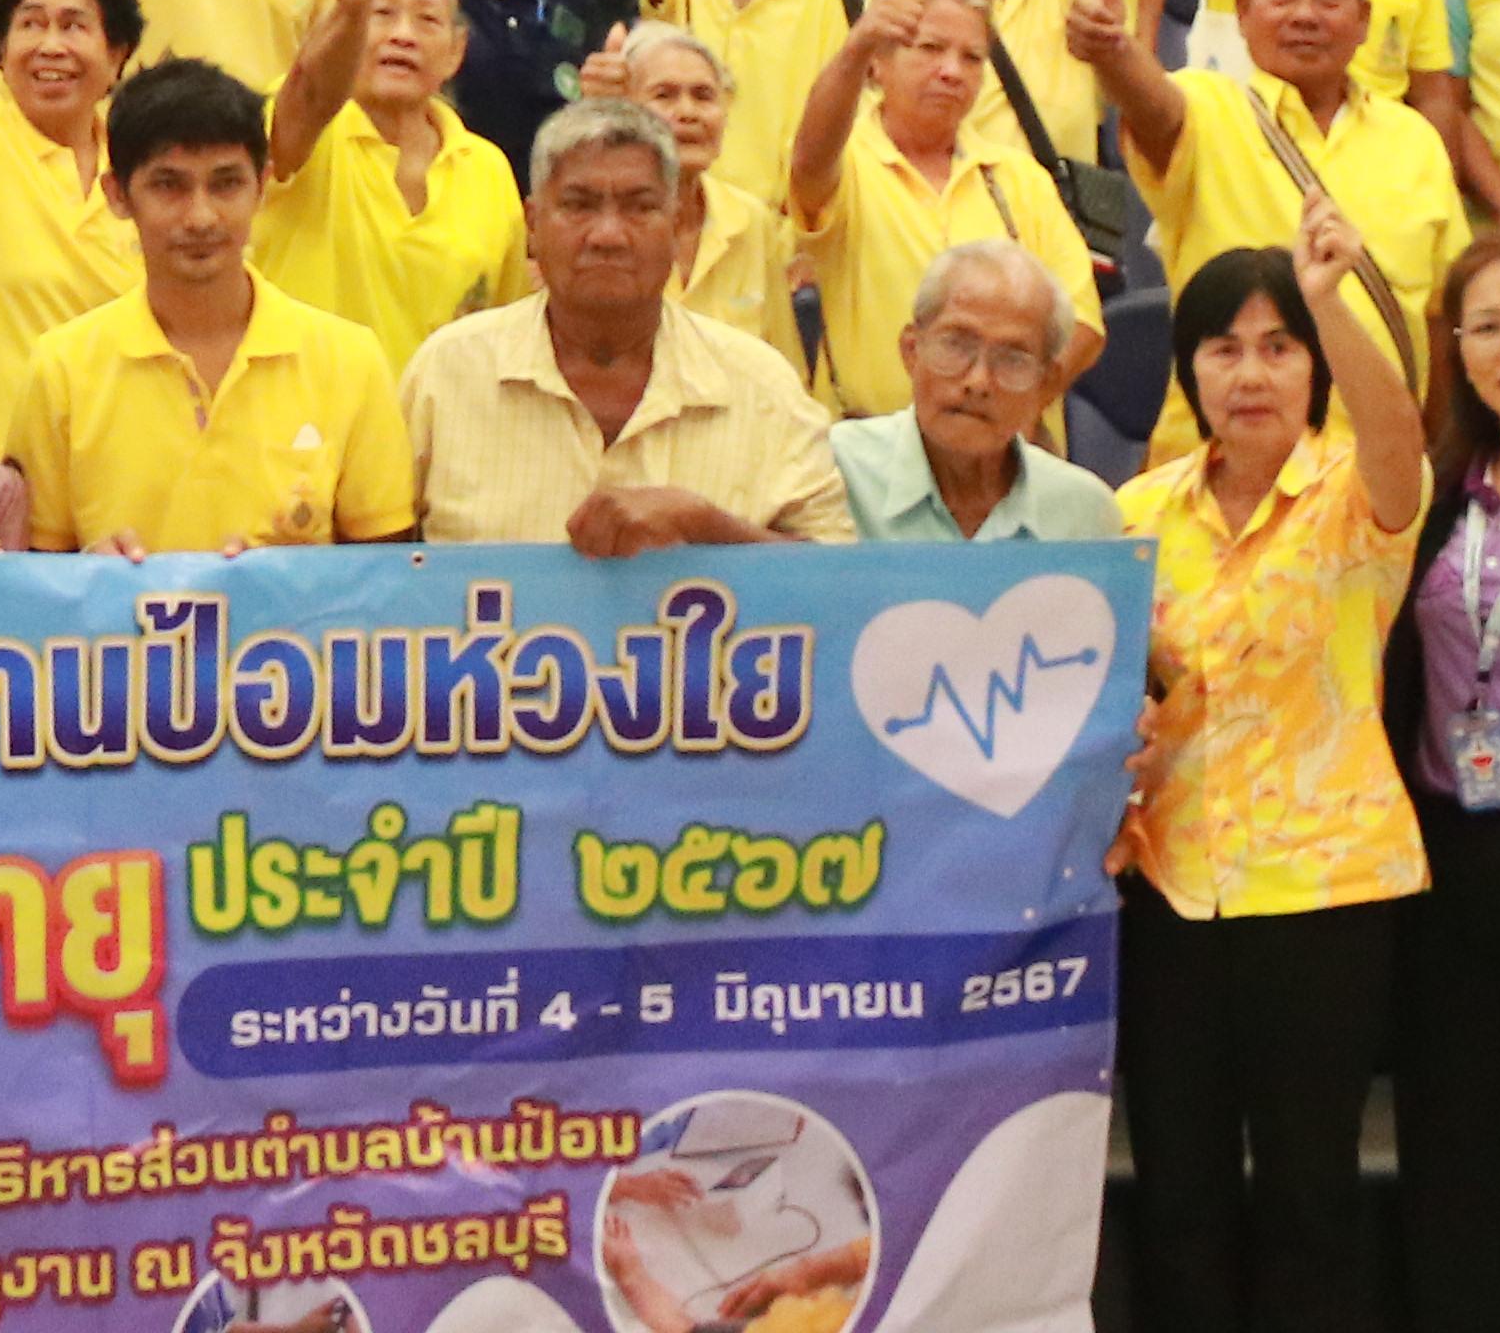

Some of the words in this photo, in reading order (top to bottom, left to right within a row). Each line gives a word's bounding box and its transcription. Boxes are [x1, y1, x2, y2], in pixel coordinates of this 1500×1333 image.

[187, 800, 522, 935] ประจำปี
[575, 819, 886, 919] ๒๕๖๗
[230, 967, 519, 1047] ระหว่างวันที่
[538, 991, 578, 1031] 4
[639, 983, 674, 1023] 5
[714, 972, 924, 1035] มิถุนายน
[960, 956, 1089, 1013] 2567
[134, 1242, 192, 1291] ณ
[212, 1195, 569, 1280] จังหวัดชลบุรี
